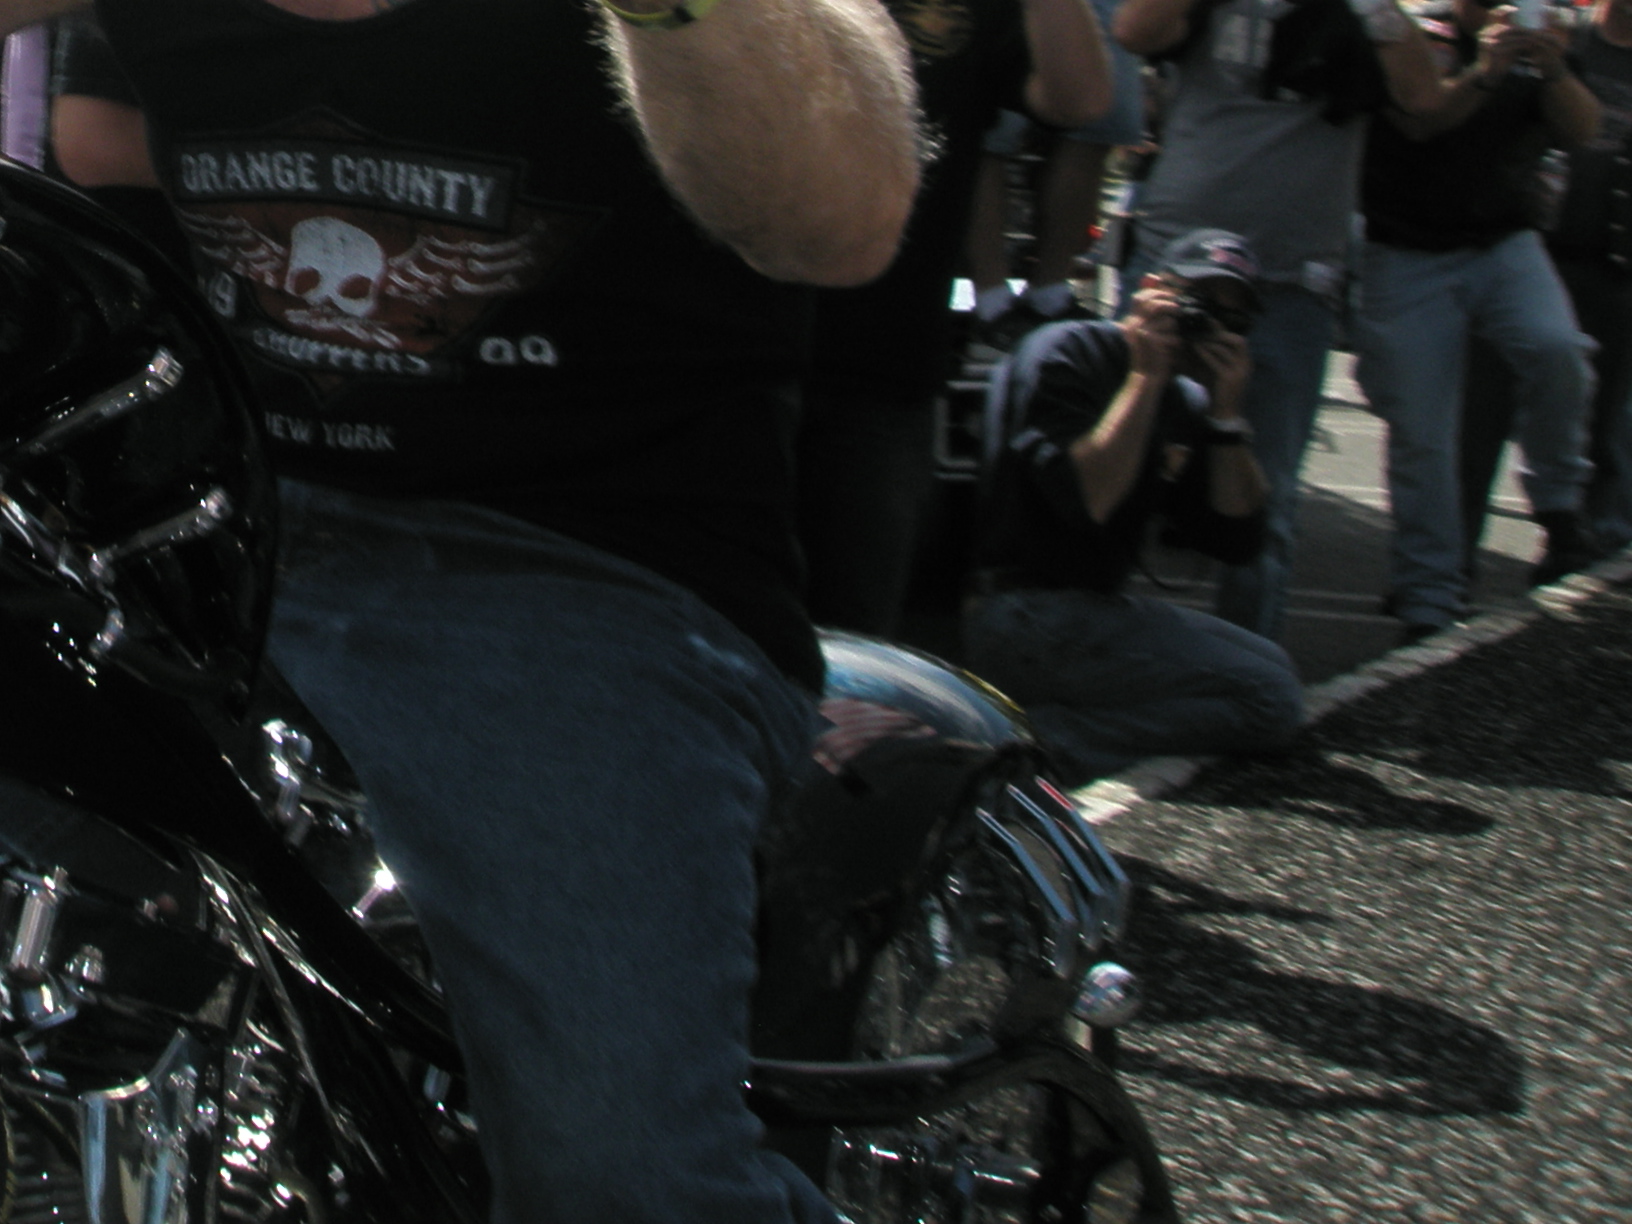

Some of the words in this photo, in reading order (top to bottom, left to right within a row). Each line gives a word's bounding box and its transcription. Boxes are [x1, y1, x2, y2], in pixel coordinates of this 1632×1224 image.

[180, 150, 321, 194] ORANGE
[331, 153, 497, 219] COUNTY
[321, 421, 396, 452] YORK
